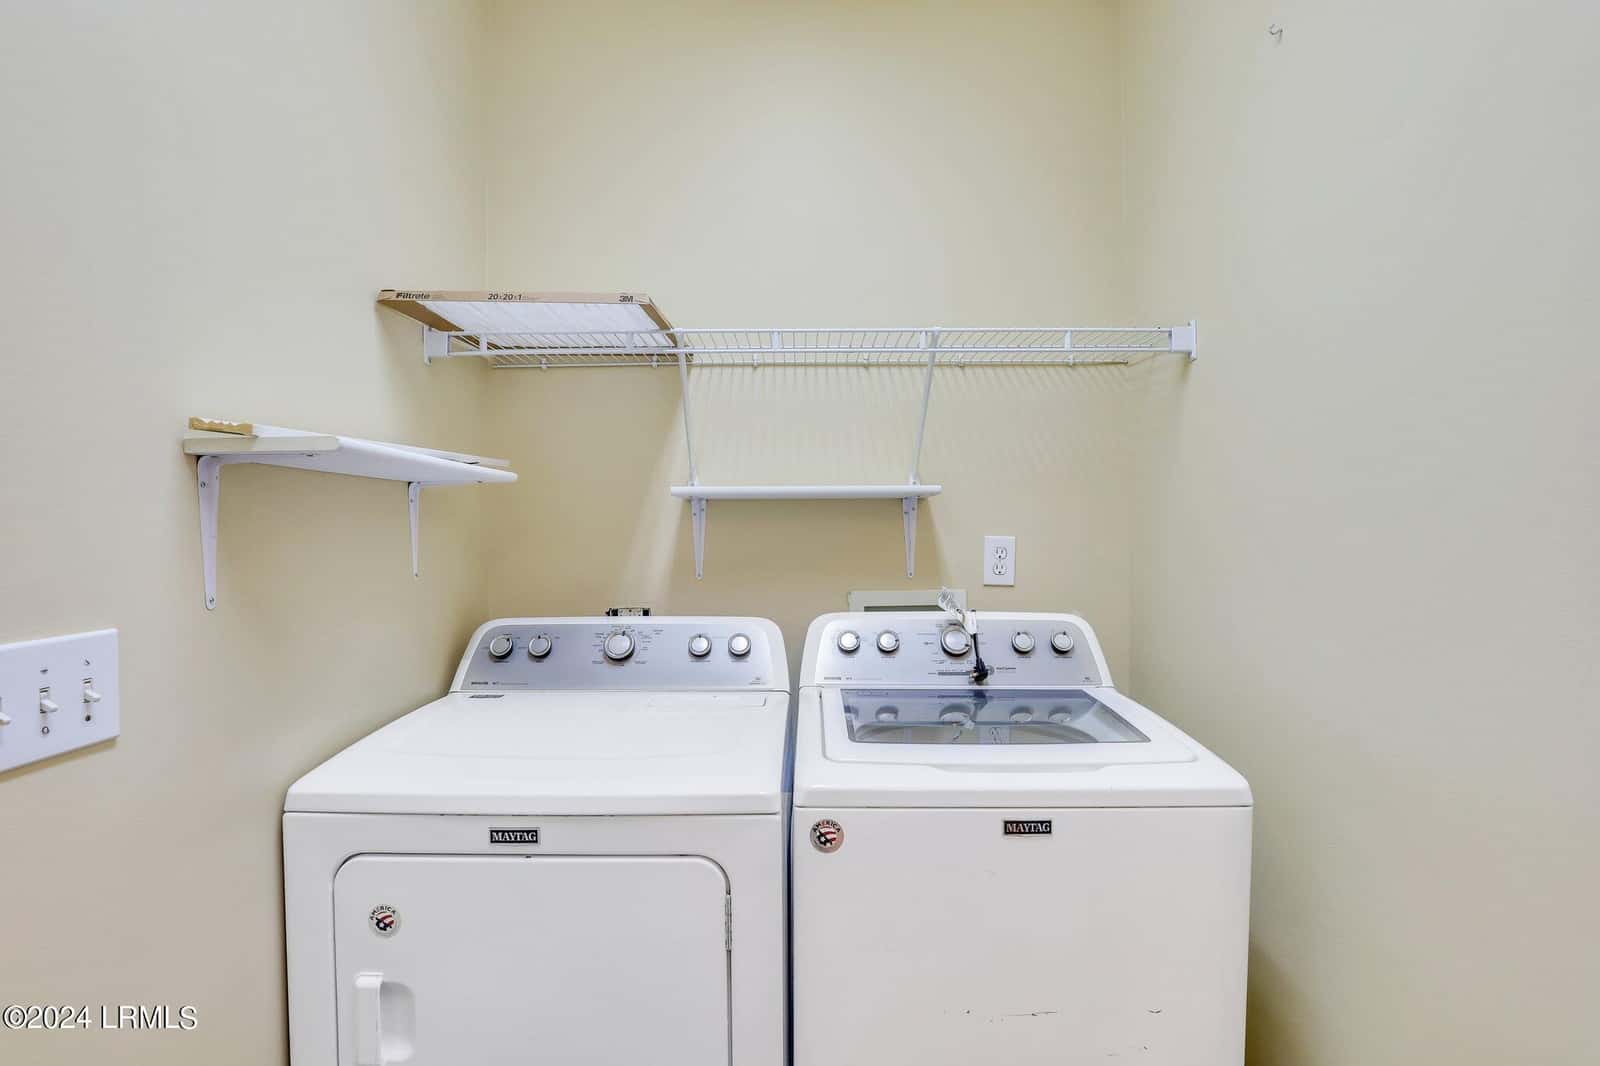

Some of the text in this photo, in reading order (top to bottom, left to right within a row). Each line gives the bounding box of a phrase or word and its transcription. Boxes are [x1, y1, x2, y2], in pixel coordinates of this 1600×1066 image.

[618, 295, 634, 303] 3M
[1006, 822, 1050, 833] MAYTAG
[491, 831, 537, 841] MAYTAG
